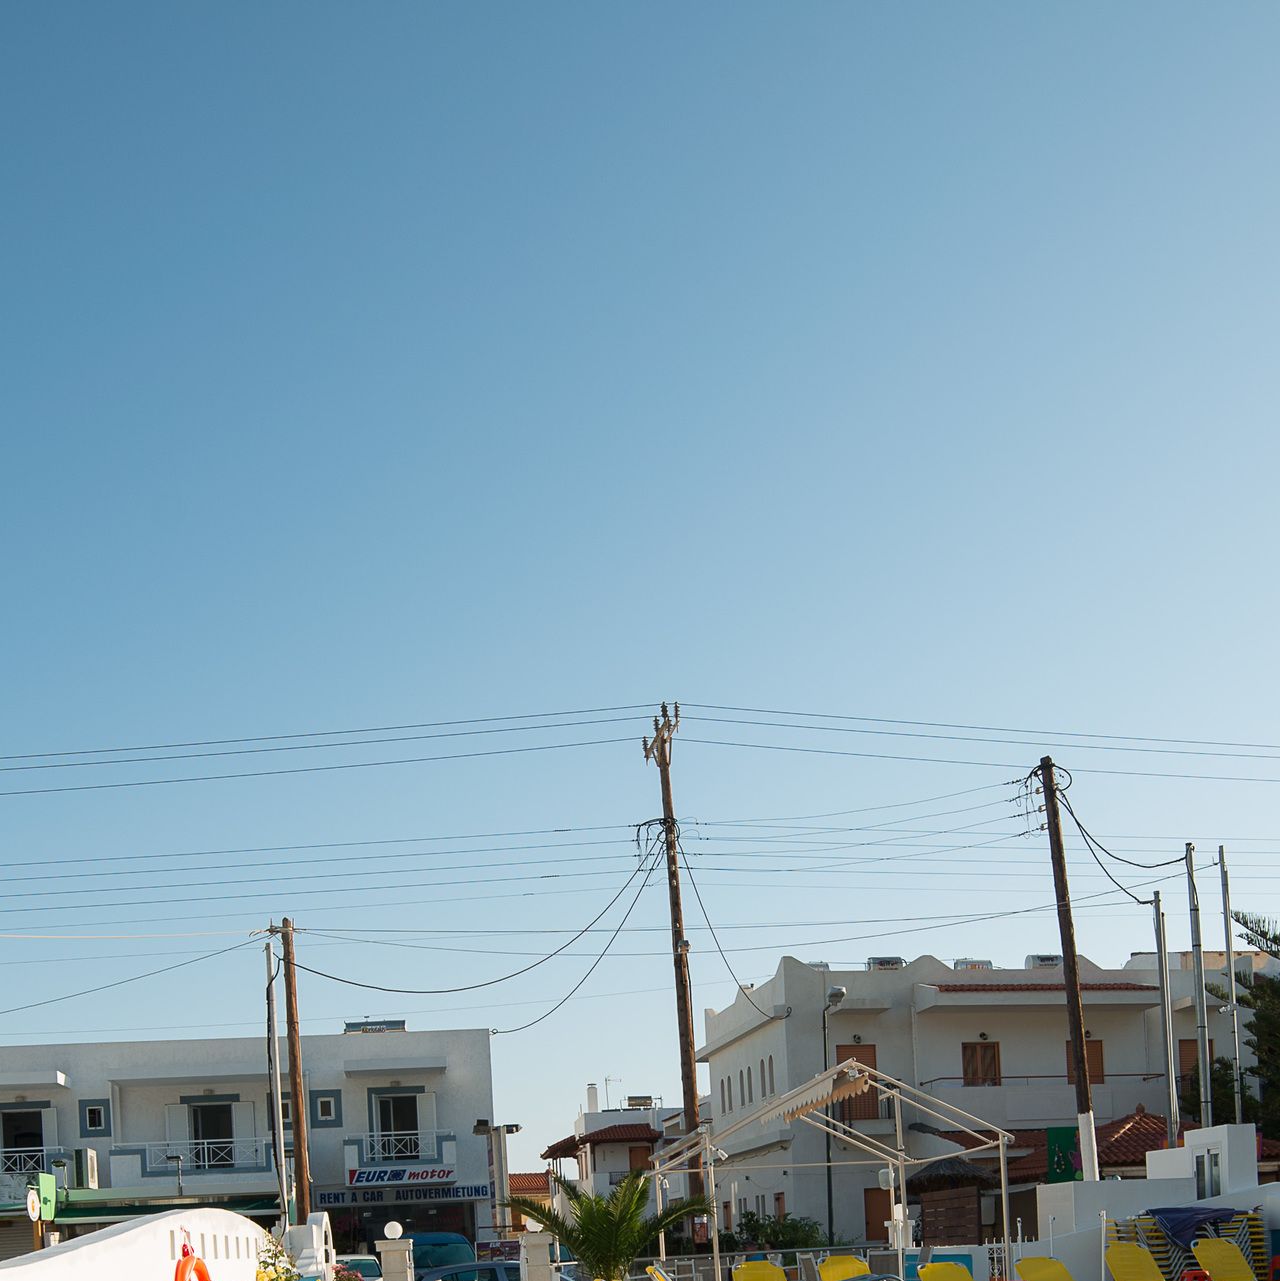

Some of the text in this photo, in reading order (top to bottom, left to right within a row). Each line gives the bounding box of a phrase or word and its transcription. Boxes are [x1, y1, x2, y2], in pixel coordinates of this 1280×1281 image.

[407, 1168, 454, 1181] motor
[320, 1185, 489, 1205] RENT A CAR AUTOVERMIETUNG
